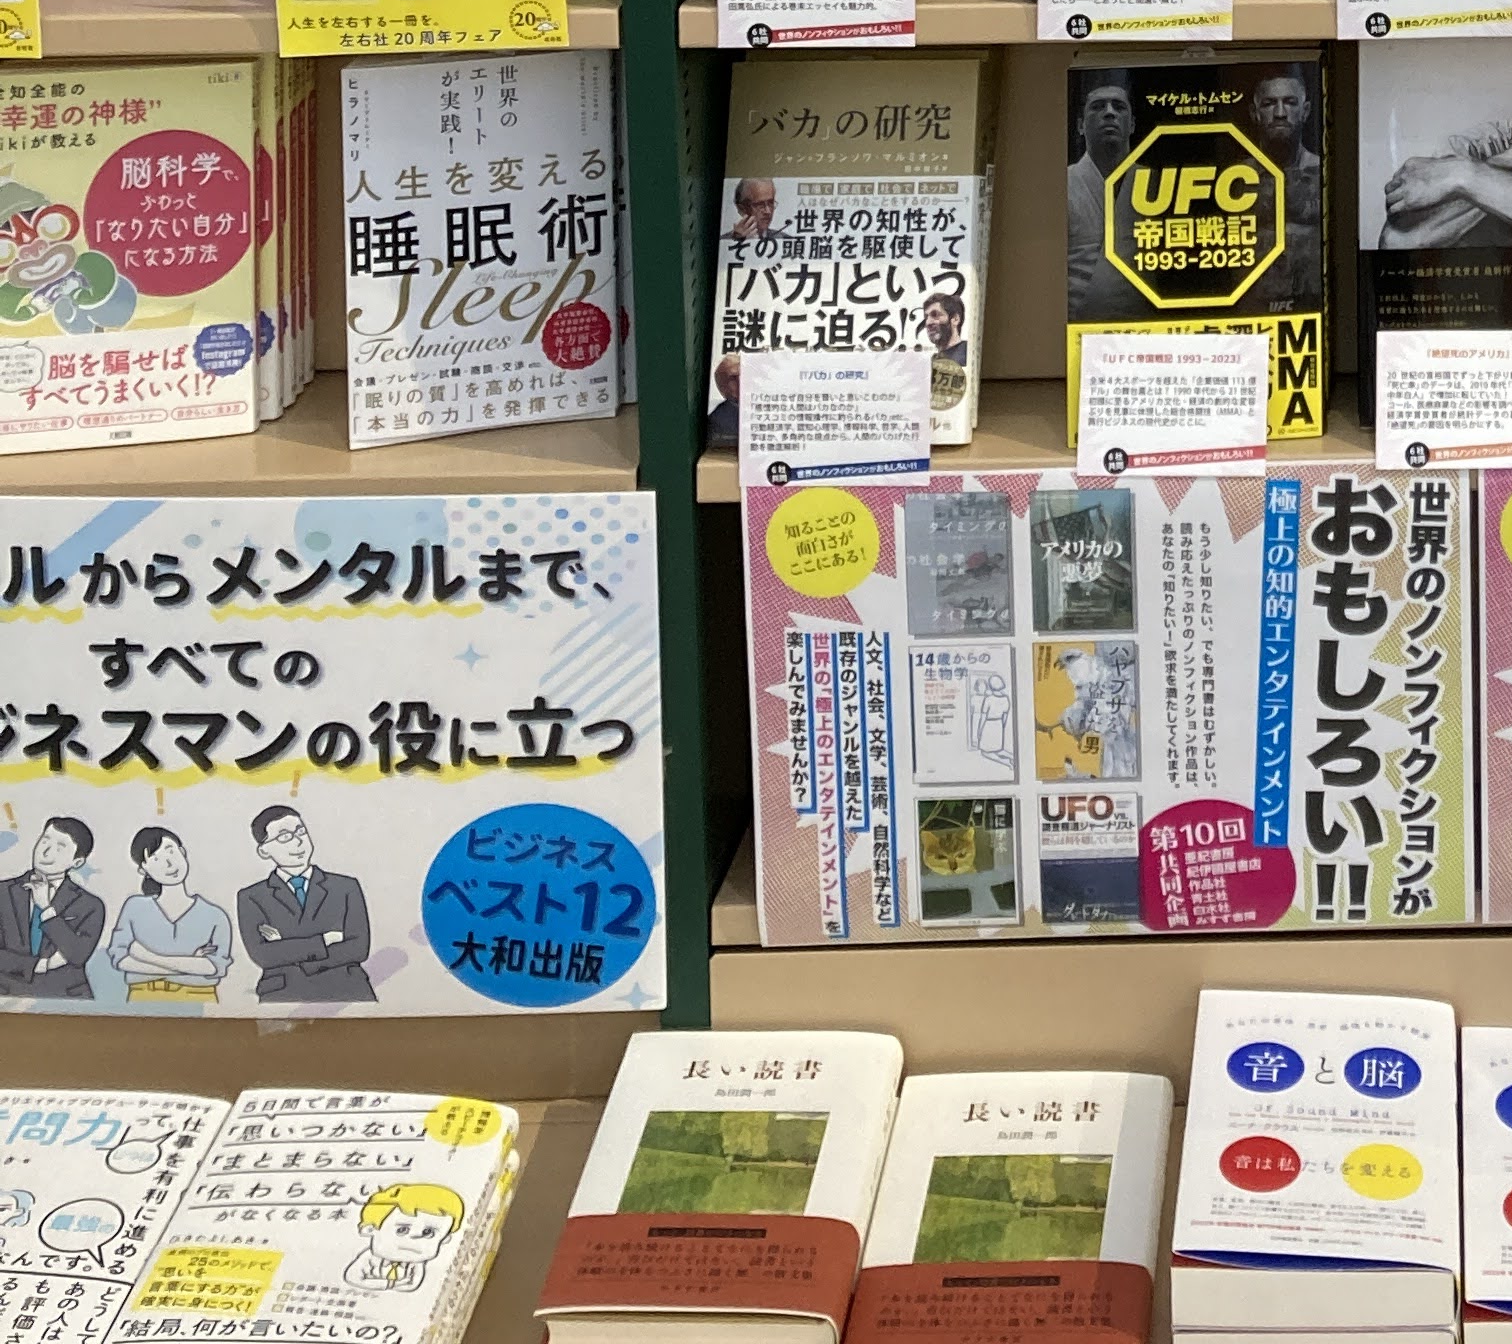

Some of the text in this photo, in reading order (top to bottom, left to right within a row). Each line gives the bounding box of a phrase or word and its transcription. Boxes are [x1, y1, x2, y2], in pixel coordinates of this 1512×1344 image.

[347, 147, 607, 204] 人生を変える
[1130, 164, 1260, 216] UFC
[350, 193, 608, 279] 睡眠術
[793, 208, 967, 234] 世界の知性が、
[1133, 215, 1257, 249] 帝国戦記
[124, 245, 219, 268] になる方法
[727, 235, 963, 261] その頭脳を駆使して
[1133, 248, 1256, 272] 1993-2023
[88, 637, 322, 690] すべての
[1255, 486, 1298, 842] 極上の知的エンタテインメント
[1304, 476, 1399, 923] おもしろい!!
[1392, 481, 1452, 918] 世界のノンフィクションが
[466, 827, 618, 872] ビジネス
[427, 880, 643, 939] ベスト12
[451, 932, 606, 984] 大和出版
[682, 1059, 824, 1082] 長い読書
[963, 1102, 1102, 1124] 長い読書
[215, 1208, 348, 1223] がなくなる本
